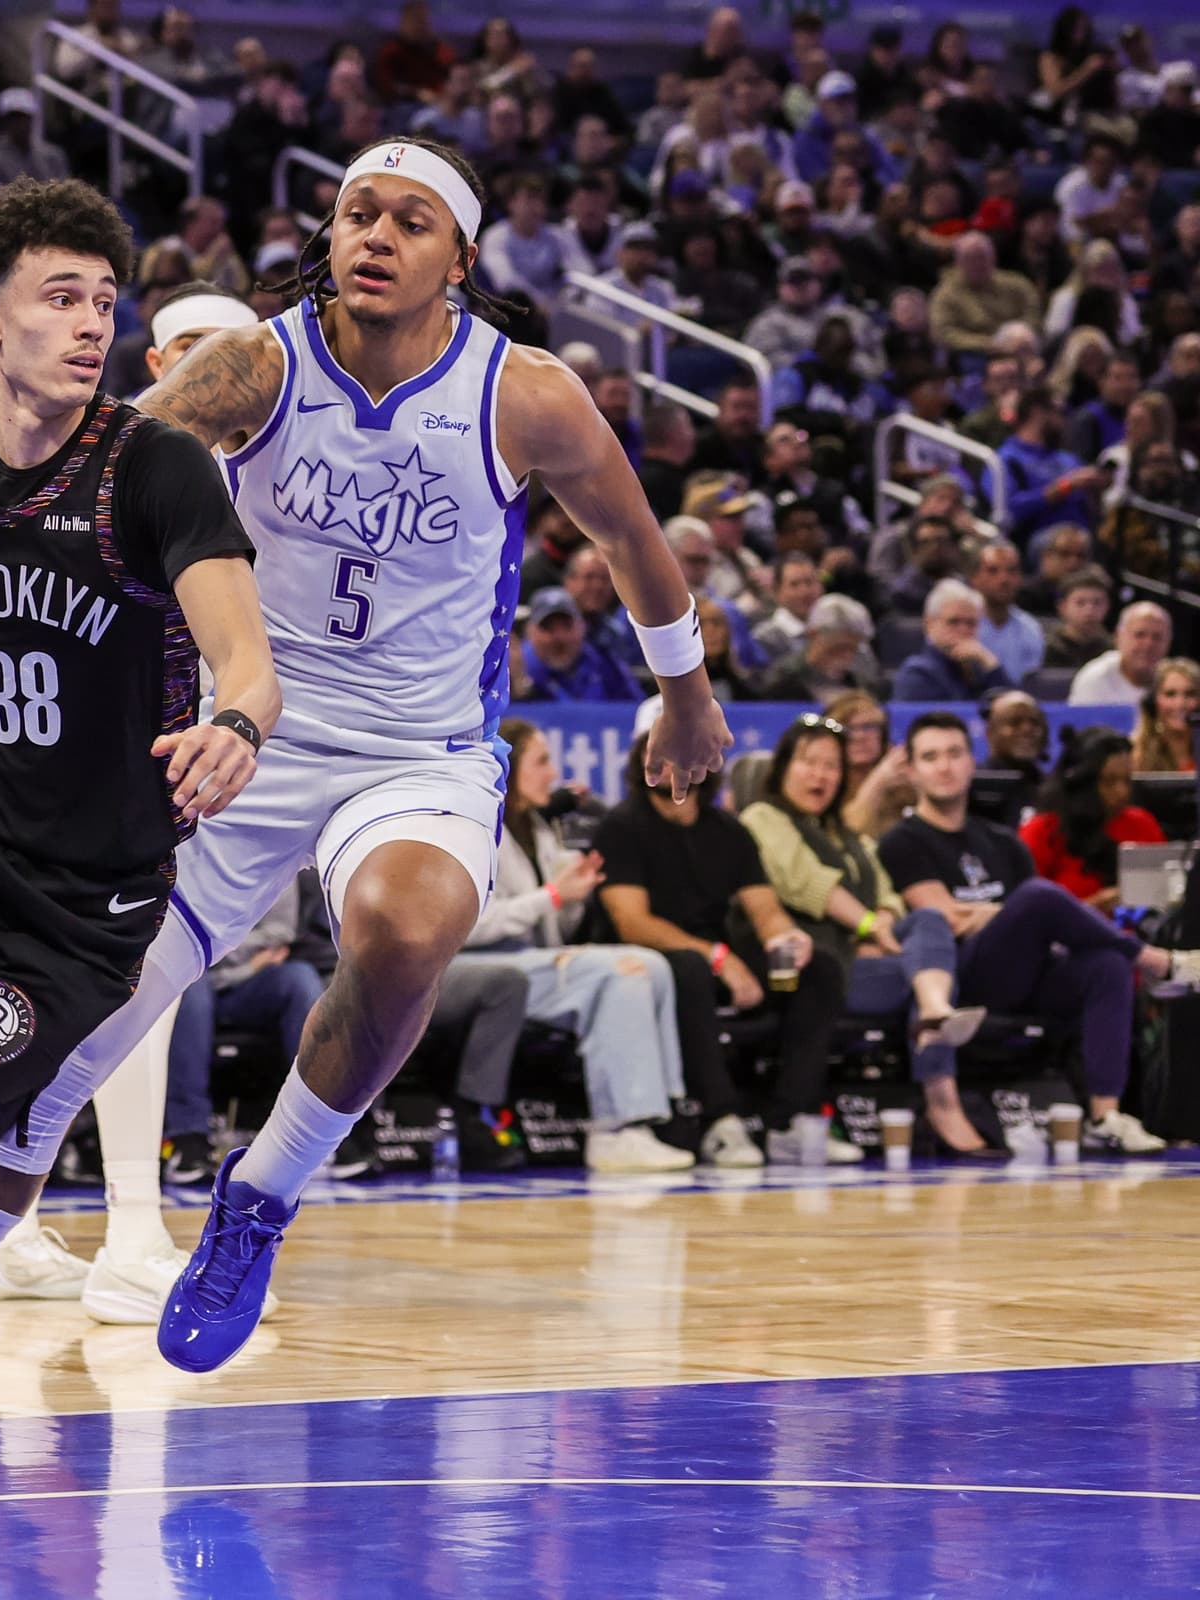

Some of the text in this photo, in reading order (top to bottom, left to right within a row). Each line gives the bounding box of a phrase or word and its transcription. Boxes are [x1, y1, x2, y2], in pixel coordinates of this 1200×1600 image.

[43, 514, 90, 531] All In Won
[325, 552, 380, 644] 5
